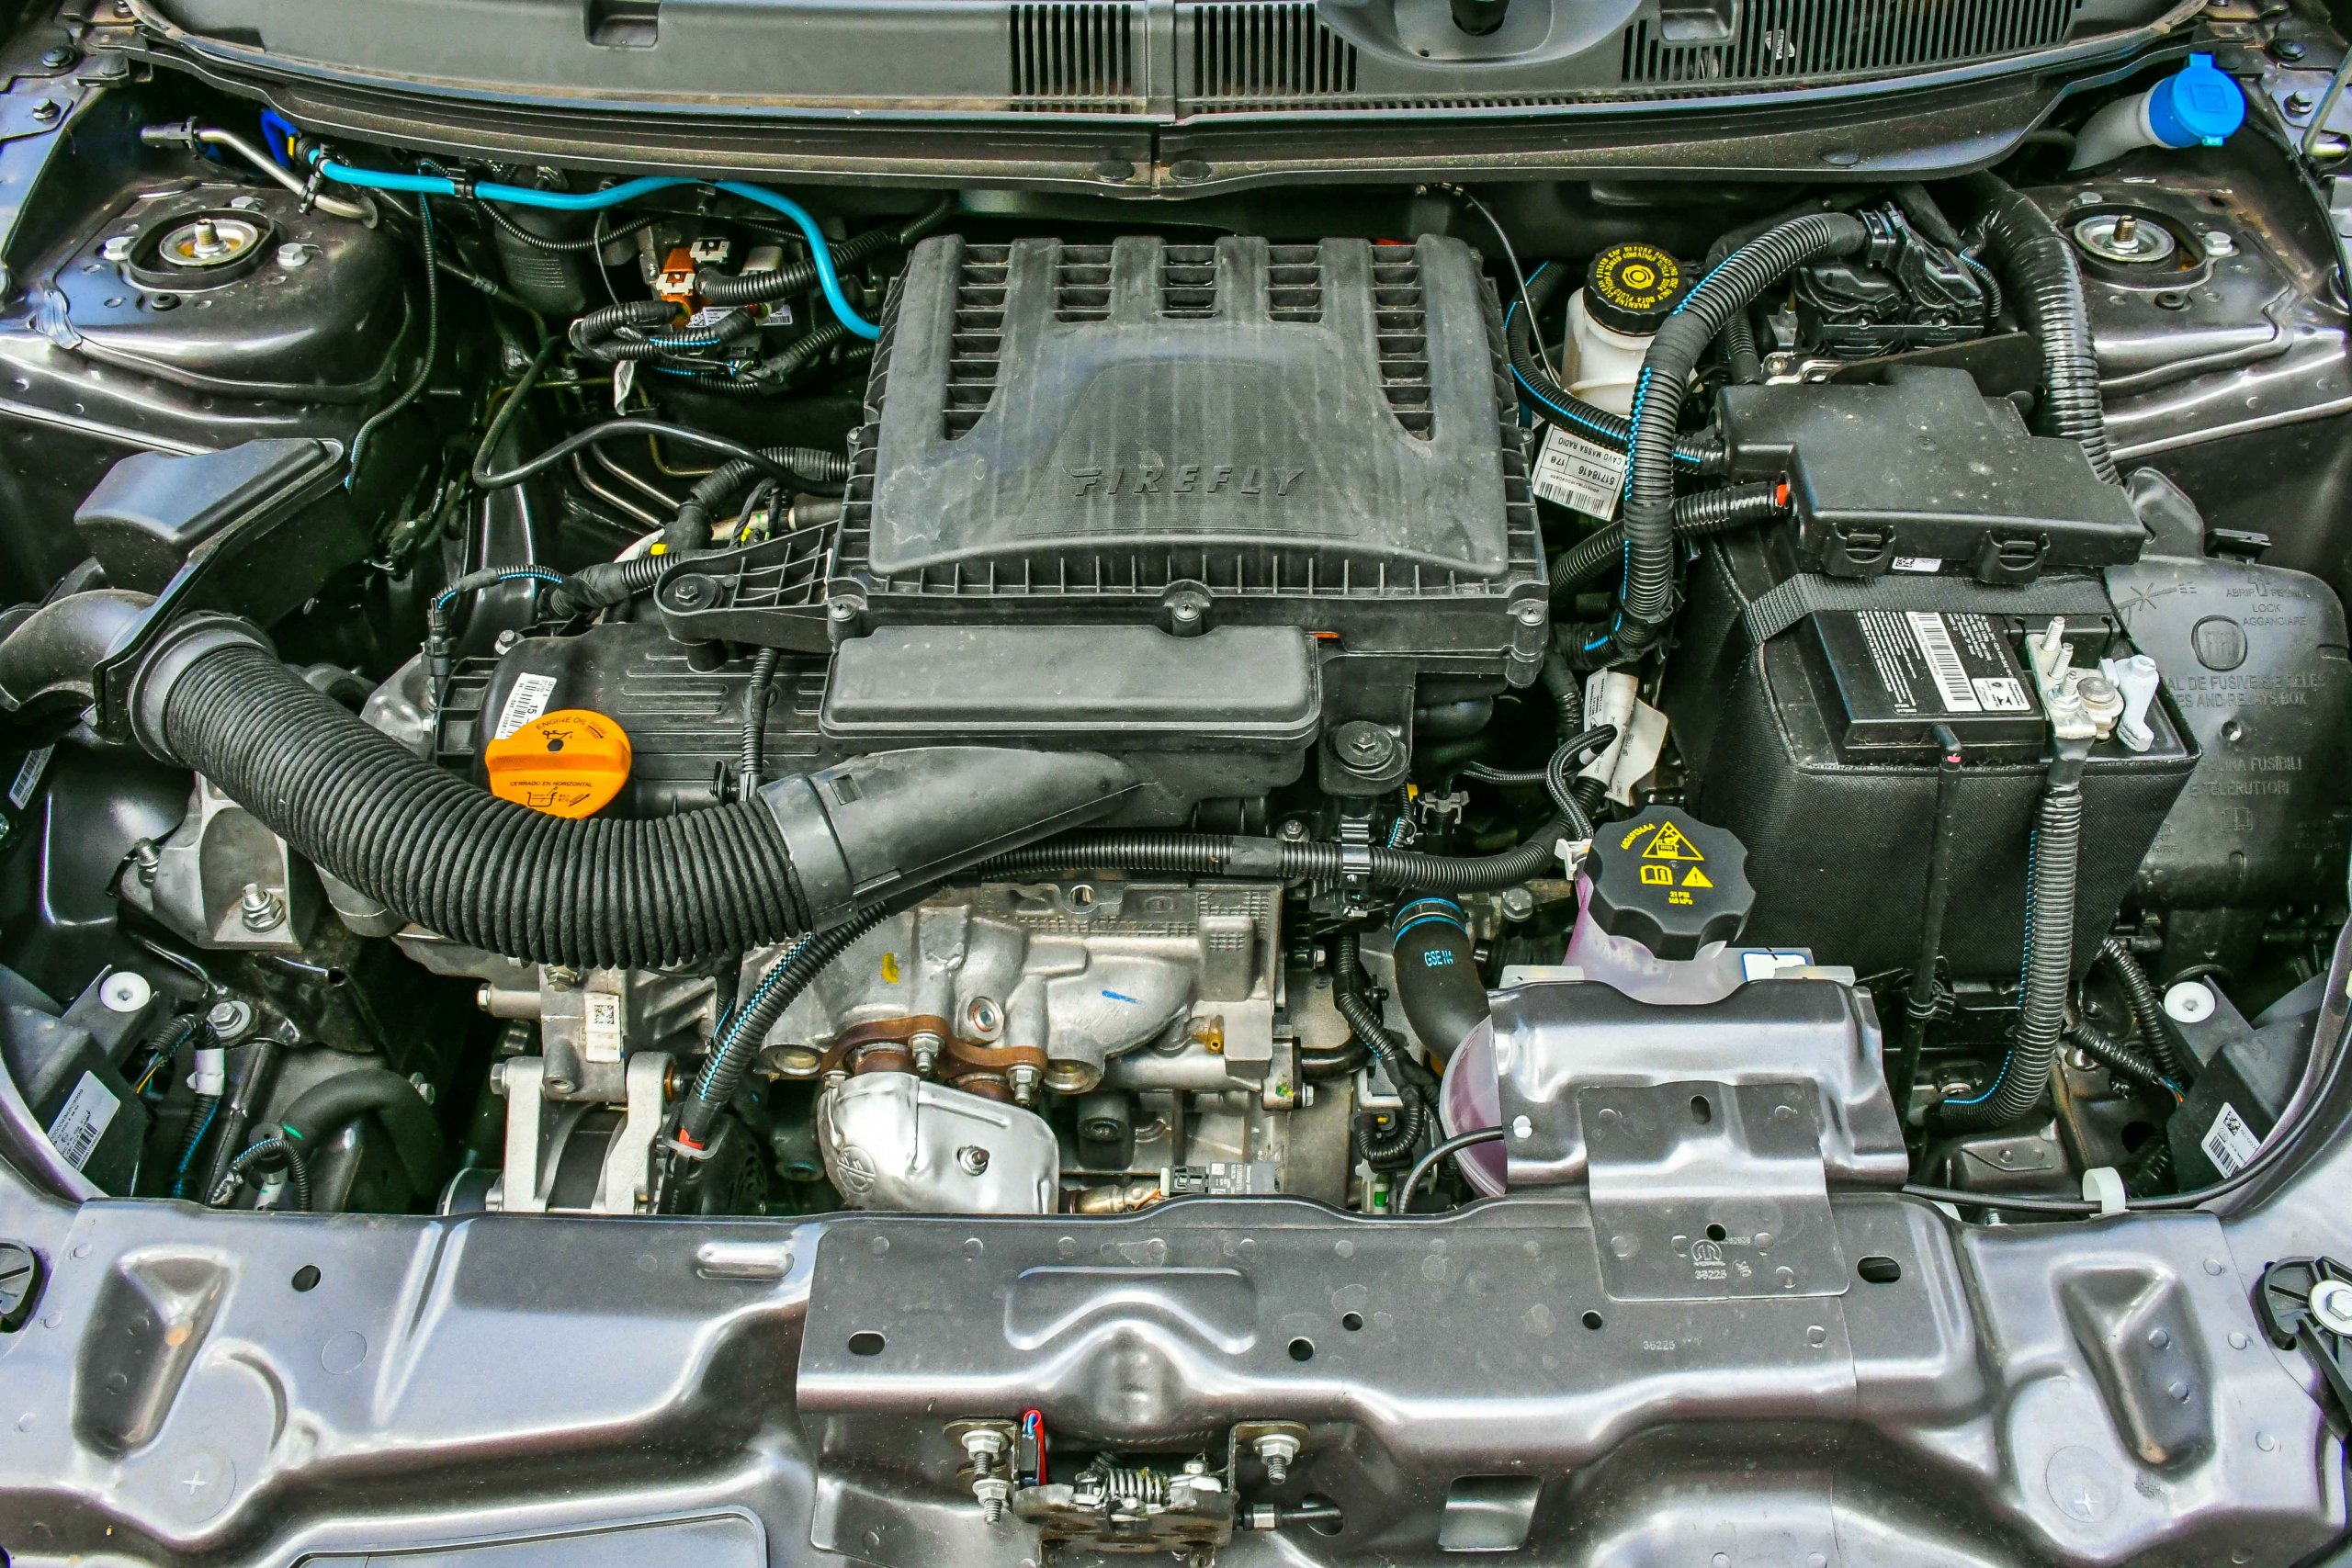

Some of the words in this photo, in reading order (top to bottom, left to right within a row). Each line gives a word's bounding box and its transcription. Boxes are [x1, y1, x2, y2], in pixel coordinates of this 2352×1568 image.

[1558, 436, 1578, 450] RADIO
[1579, 444, 1602, 458] MASSA
[1550, 456, 1565, 467] 178
[1603, 453, 1623, 466] CAVO
[1070, 465, 1305, 497] FIREFLY
[1578, 465, 1616, 486] 51718416
[2252, 604, 2281, 613] LOCK
[536, 716, 571, 730] ENGINE
[573, 716, 586, 726] OIL
